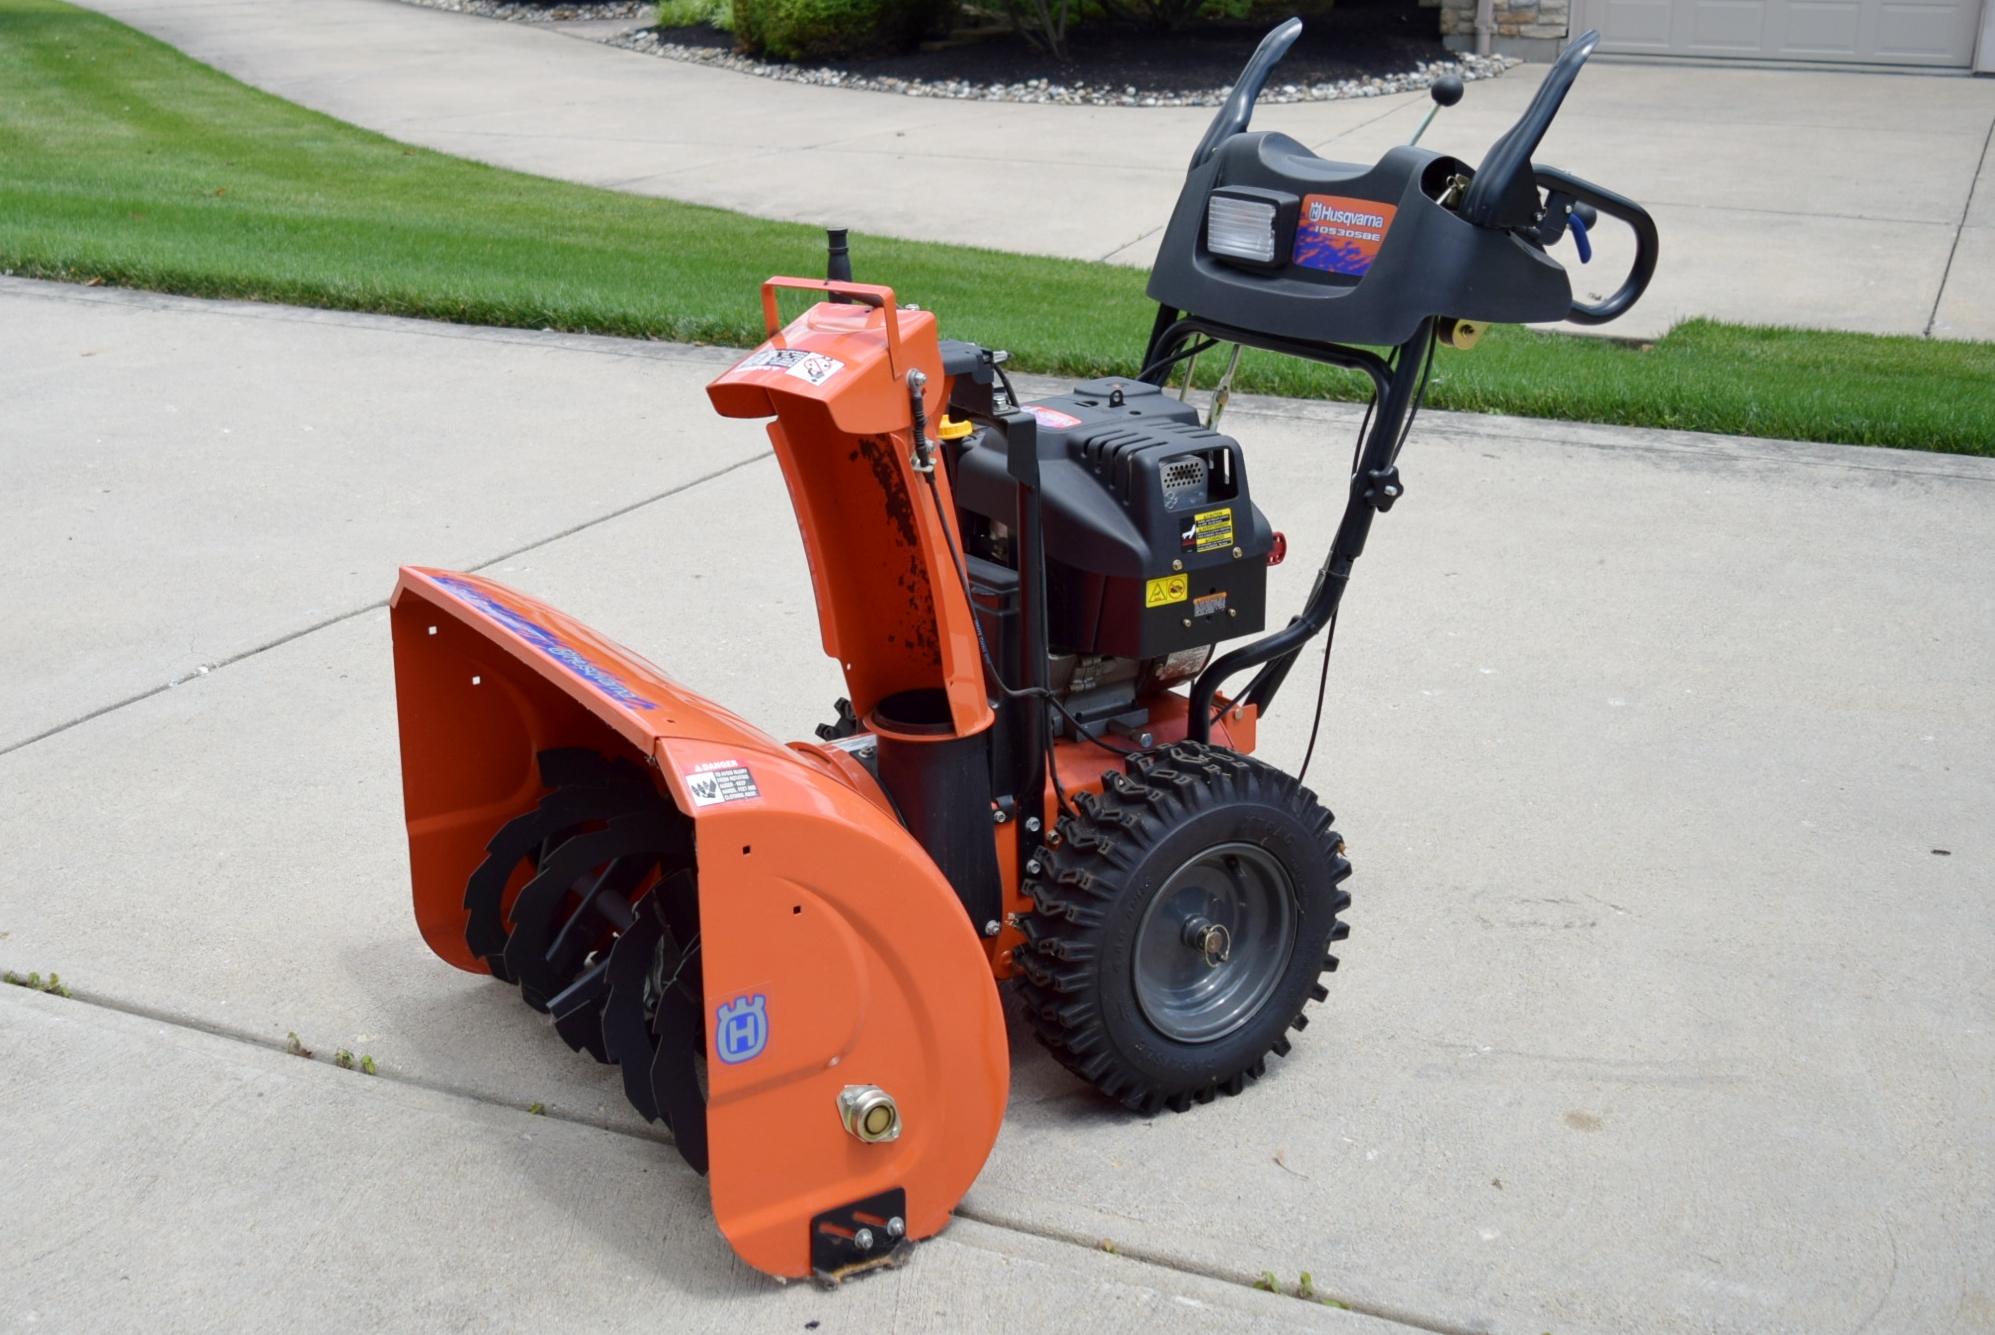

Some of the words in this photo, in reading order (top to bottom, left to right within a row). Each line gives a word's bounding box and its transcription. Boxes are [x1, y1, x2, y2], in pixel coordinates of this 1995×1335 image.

[1321, 206, 1384, 228] Husqvarna
[701, 759, 738, 771] DANGER
[721, 769, 734, 777] AVOID
